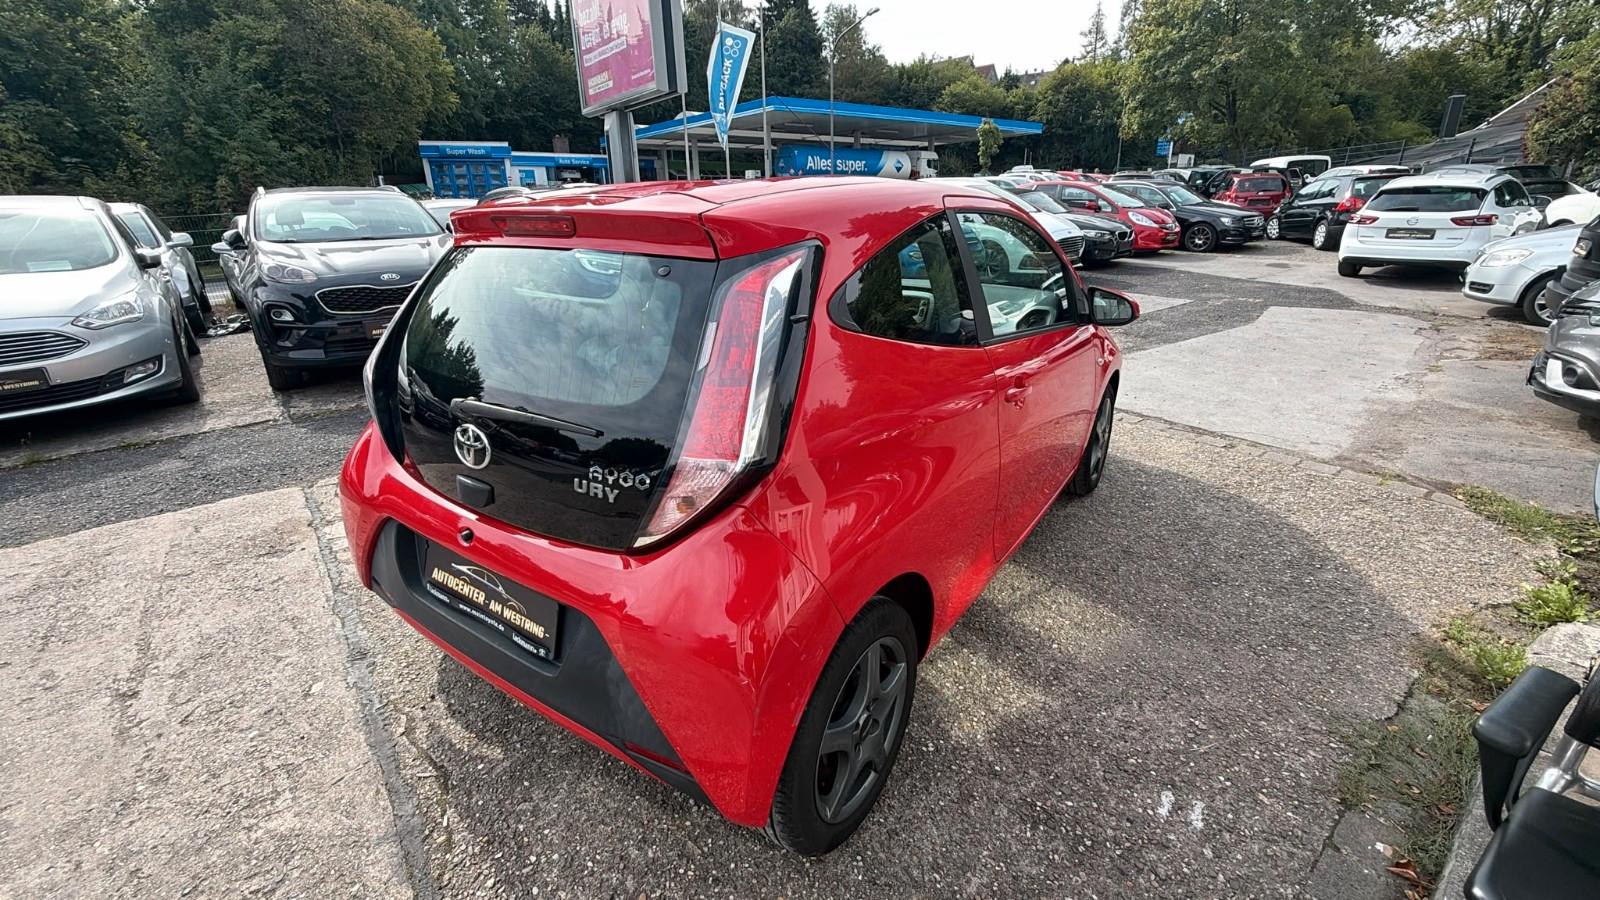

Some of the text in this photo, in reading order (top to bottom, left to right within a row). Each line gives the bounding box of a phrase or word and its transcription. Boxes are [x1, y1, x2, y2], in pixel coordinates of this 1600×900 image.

[445, 148, 466, 157] Super
[806, 155, 868, 174] Alles super.
[573, 477, 620, 503] URY
[588, 465, 651, 491] AYGO
[489, 599, 502, 615] AM
[503, 605, 545, 639] WESTRING
